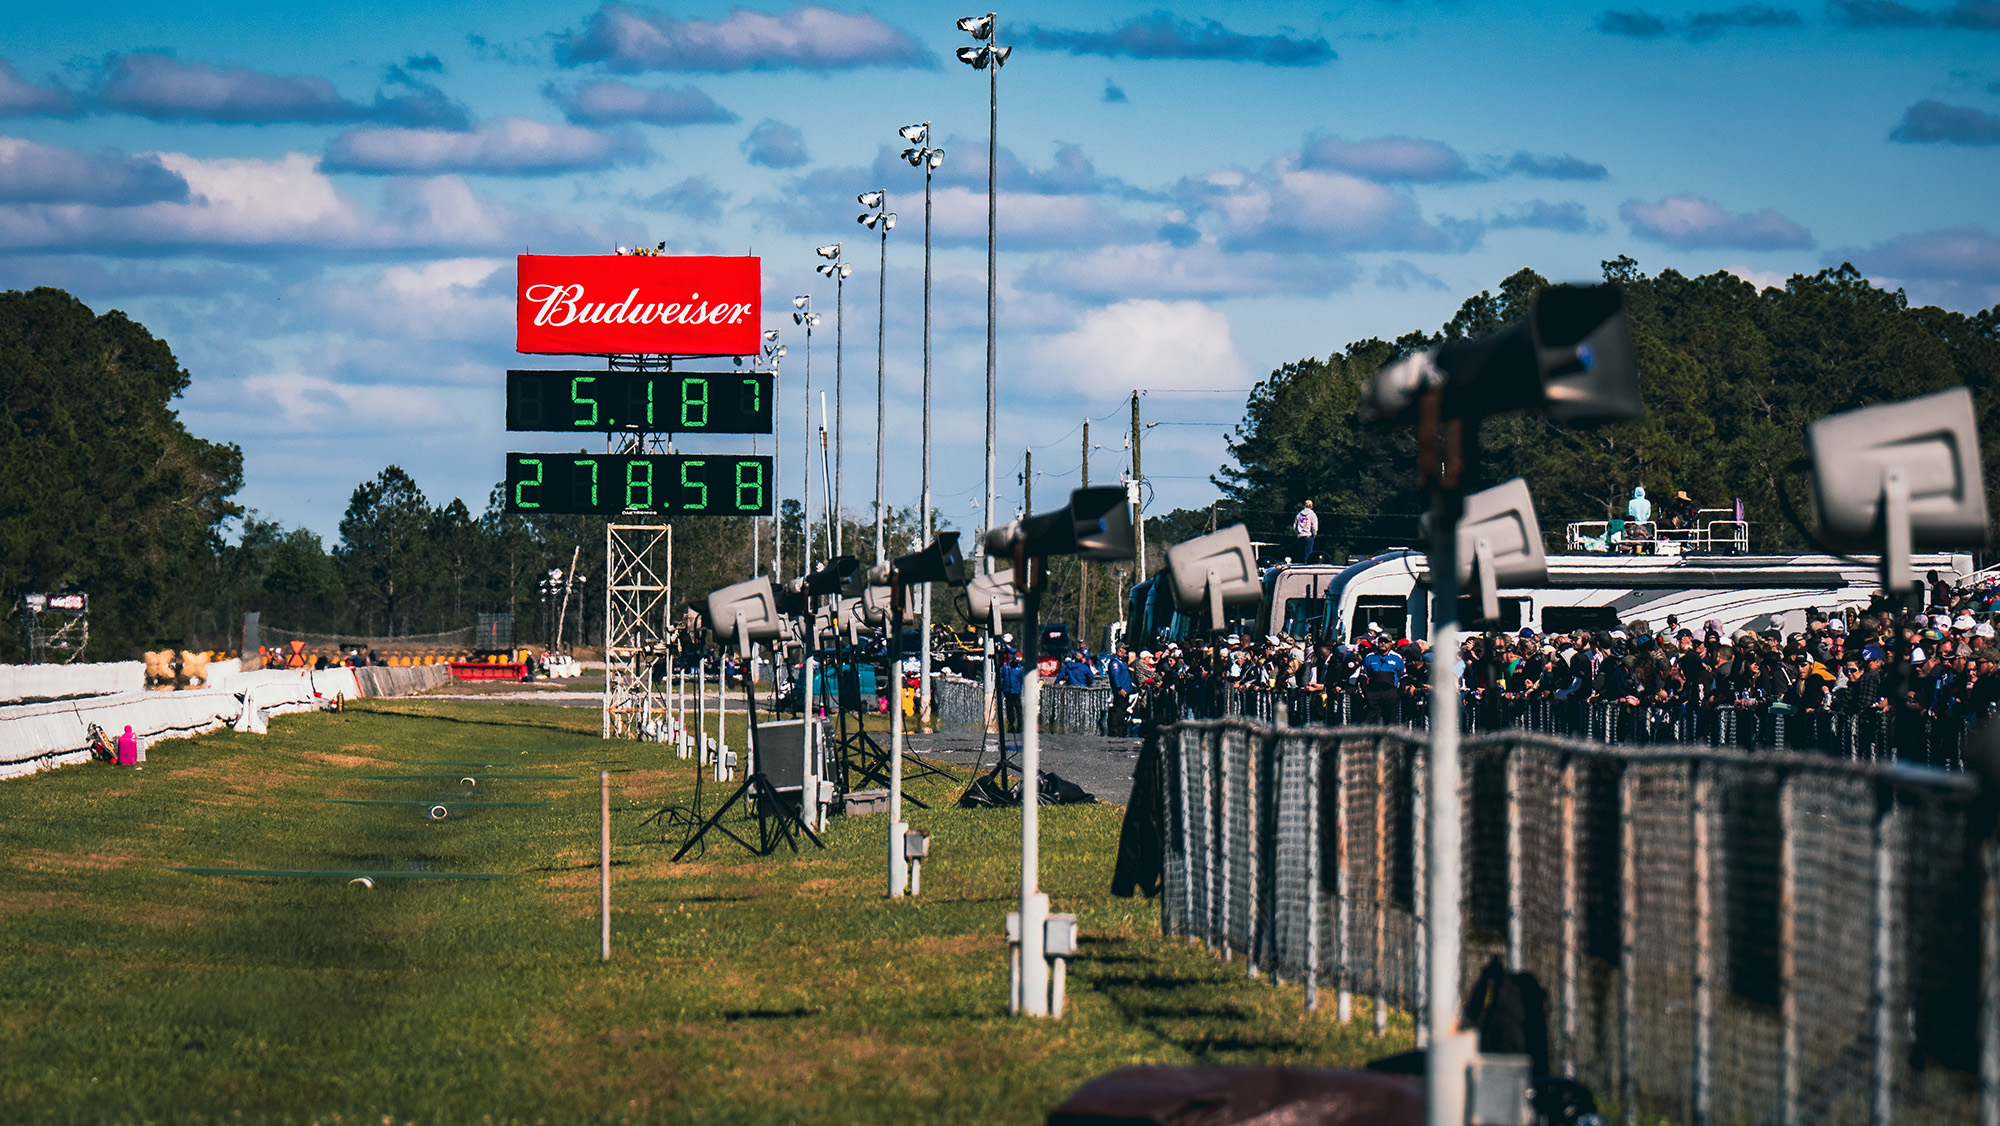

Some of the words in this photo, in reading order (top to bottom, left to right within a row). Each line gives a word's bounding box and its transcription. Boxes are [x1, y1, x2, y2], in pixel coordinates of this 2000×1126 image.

[526, 284, 751, 326] Budweiser
[571, 377, 759, 426] 5.187
[515, 459, 762, 509] 278.58
